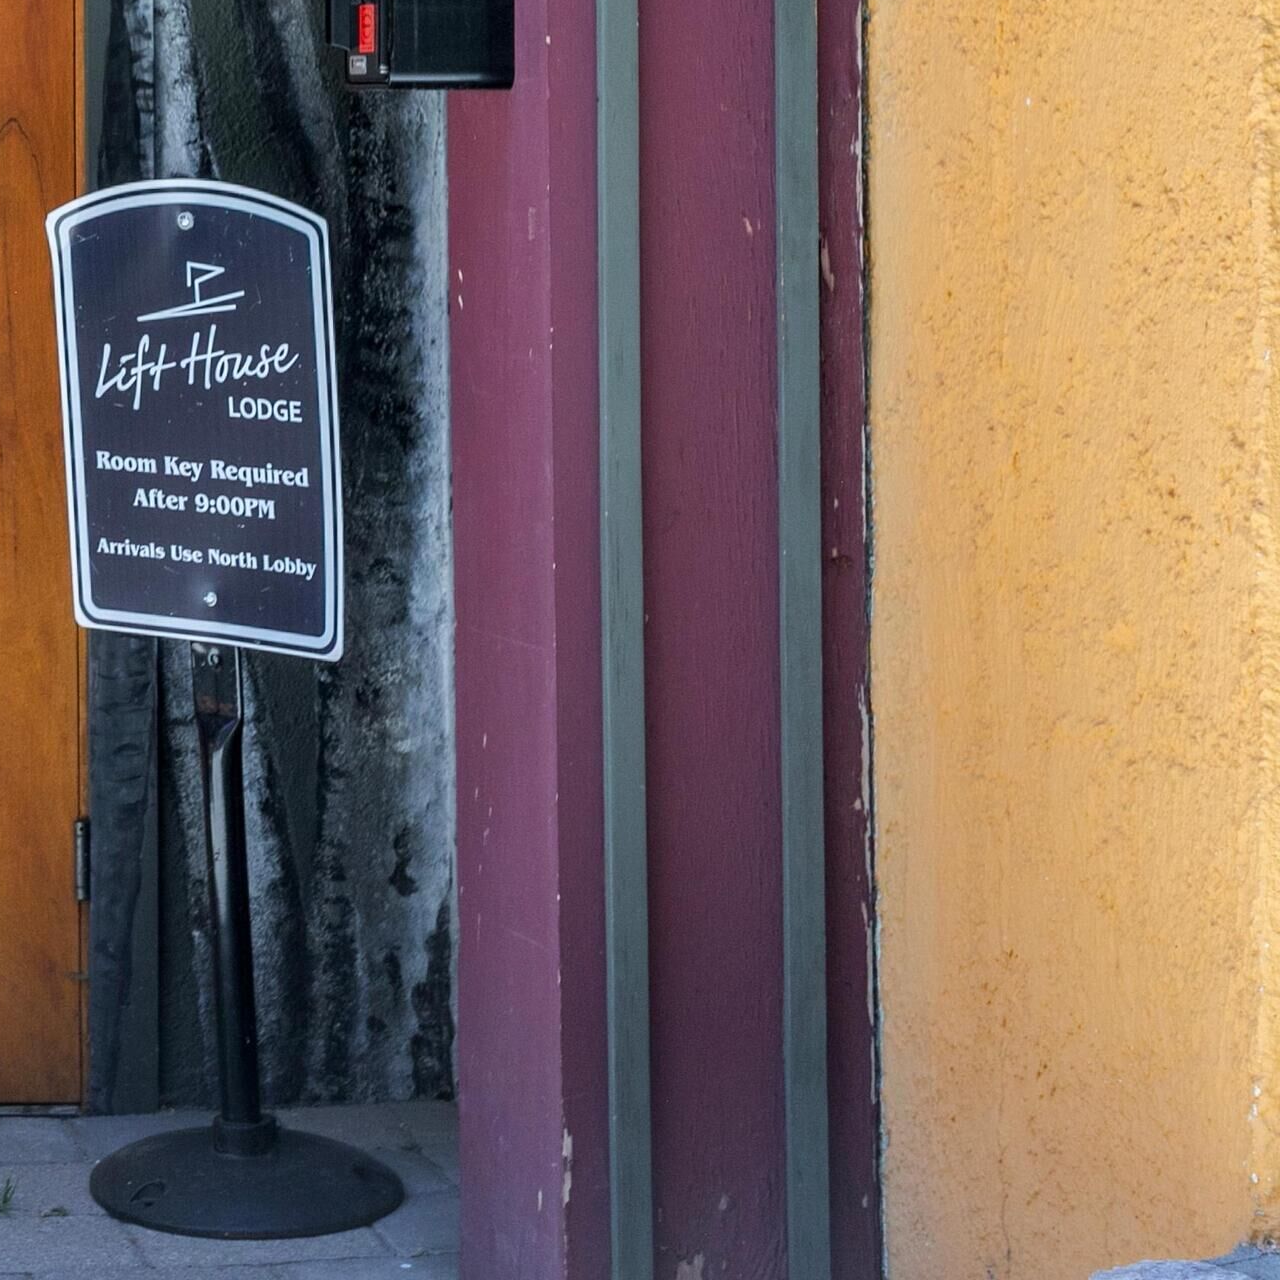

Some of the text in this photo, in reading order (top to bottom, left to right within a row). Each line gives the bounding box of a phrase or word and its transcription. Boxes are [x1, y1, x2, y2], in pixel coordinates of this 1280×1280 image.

[95, 324, 300, 410] Lift House
[228, 397, 302, 422] LODGE
[96, 450, 309, 488] Room Key Required
[133, 487, 276, 520] After 9:00PM
[97, 537, 317, 580] Arrivals Use North Lobby
